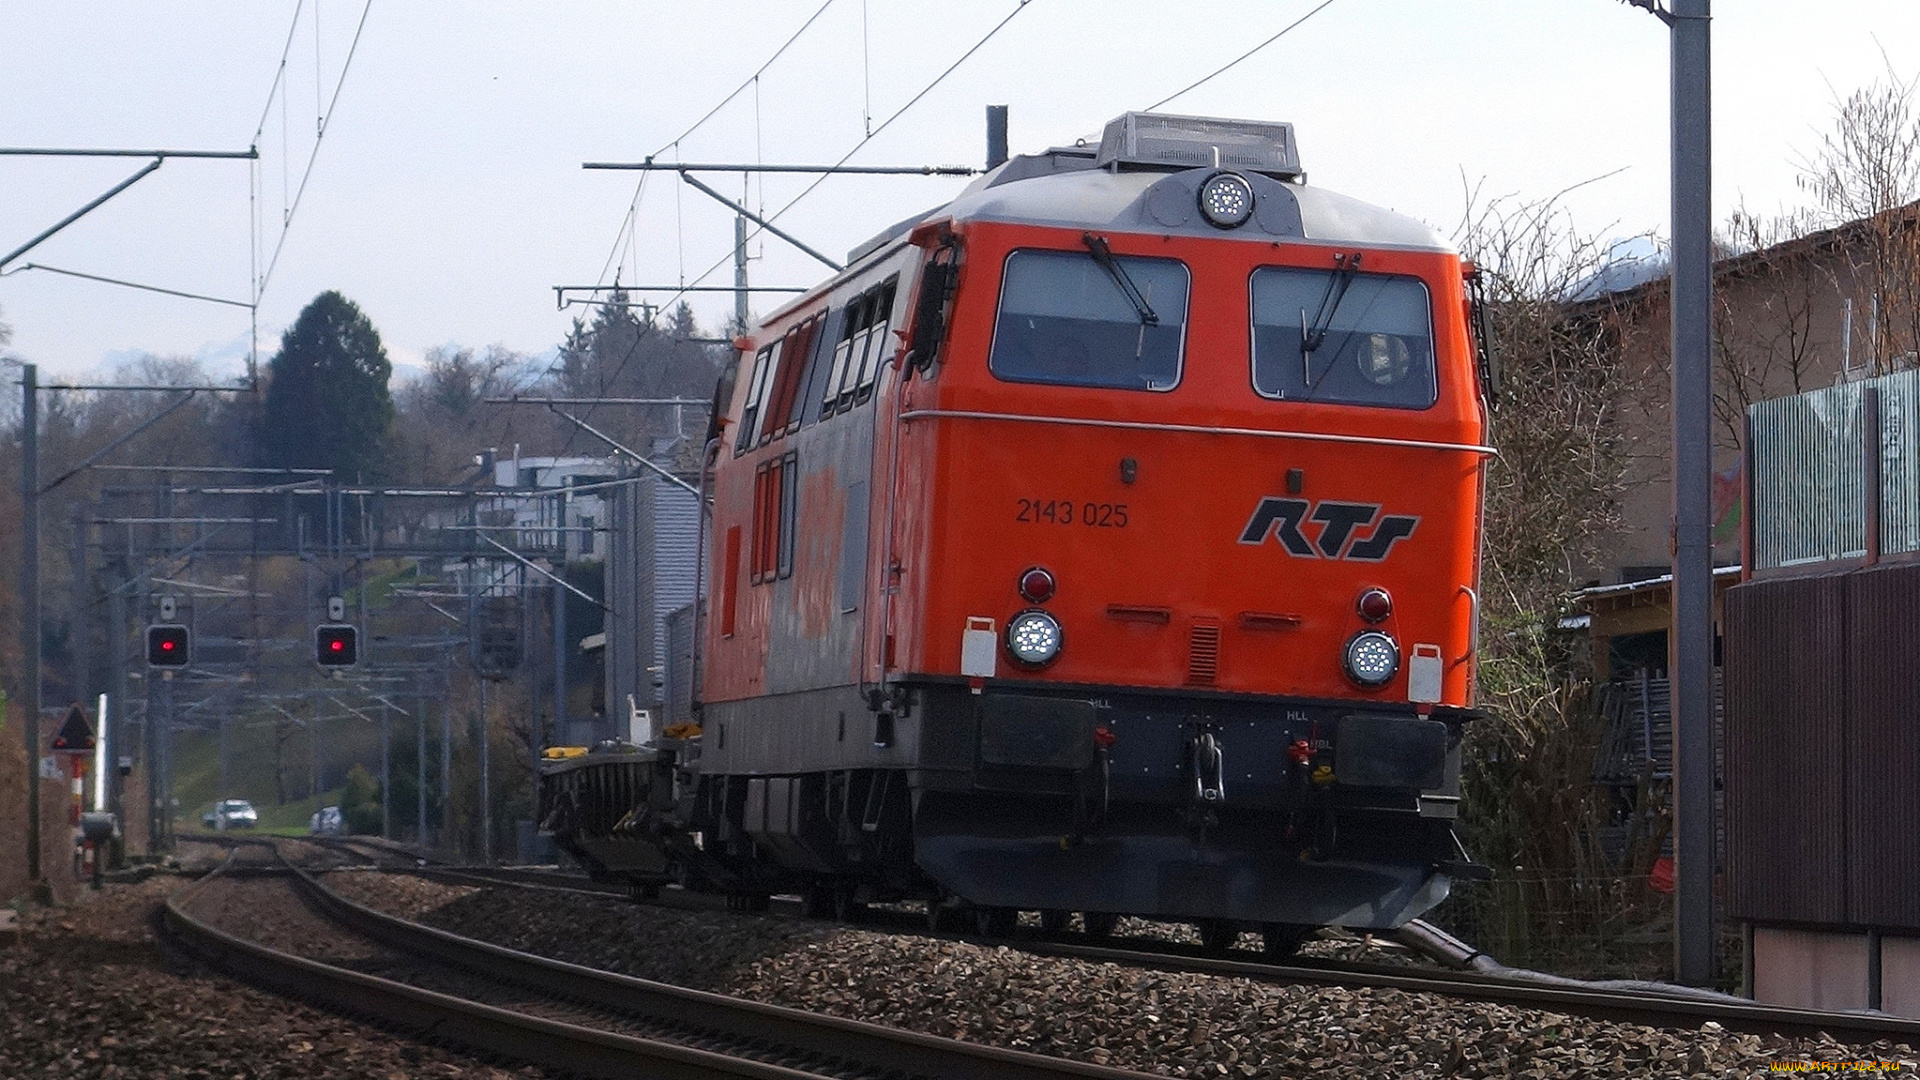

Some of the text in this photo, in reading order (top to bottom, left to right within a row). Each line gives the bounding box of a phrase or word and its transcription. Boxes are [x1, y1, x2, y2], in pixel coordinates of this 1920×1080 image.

[1016, 498, 1128, 528] 2143 025
[1238, 496, 1421, 562] RTS
[1287, 711, 1308, 721] HLL
